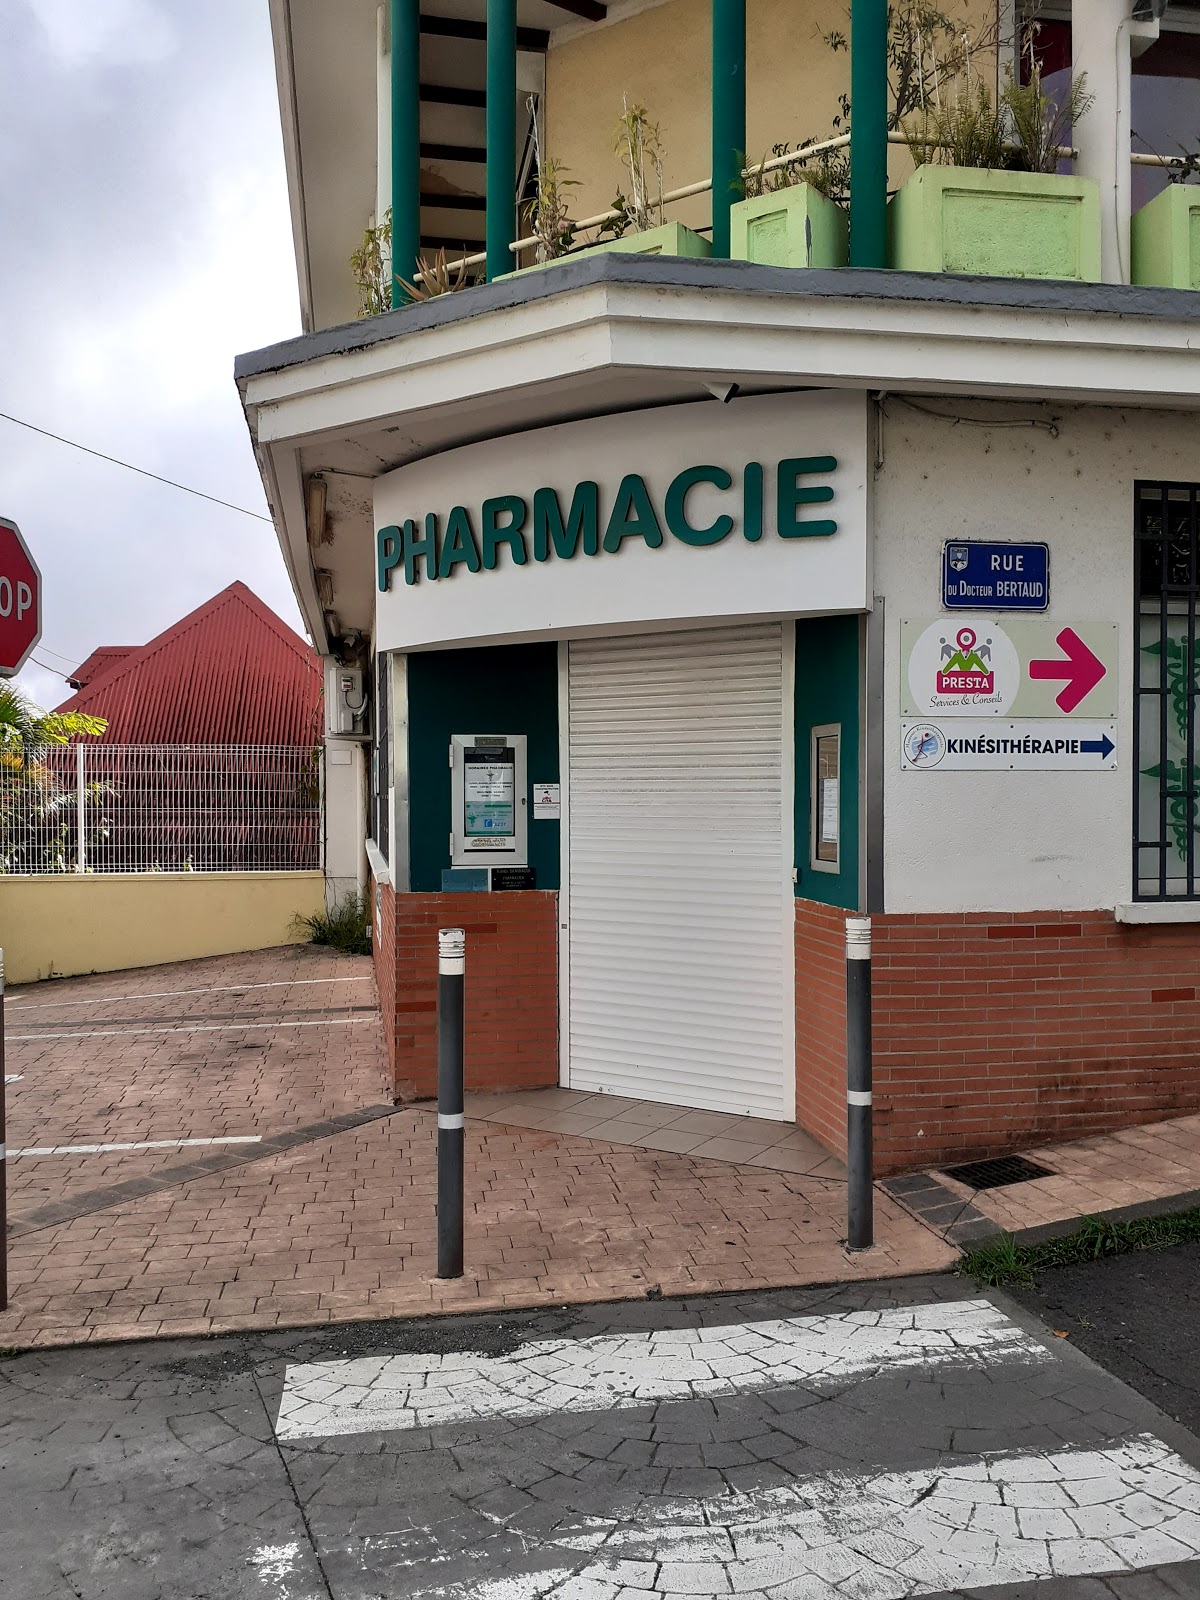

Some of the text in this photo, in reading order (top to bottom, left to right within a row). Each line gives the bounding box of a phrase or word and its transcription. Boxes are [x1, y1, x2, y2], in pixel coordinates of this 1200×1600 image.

[377, 455, 838, 593] PHARMACIE
[991, 554, 1024, 571] RUE
[948, 585, 957, 596] DU
[996, 581, 1043, 598] BERTAUD
[942, 677, 989, 689] PRESTA
[929, 691, 1003, 708] Services & Conseils
[947, 734, 1079, 754] KINÉSITHÉRAPIE
